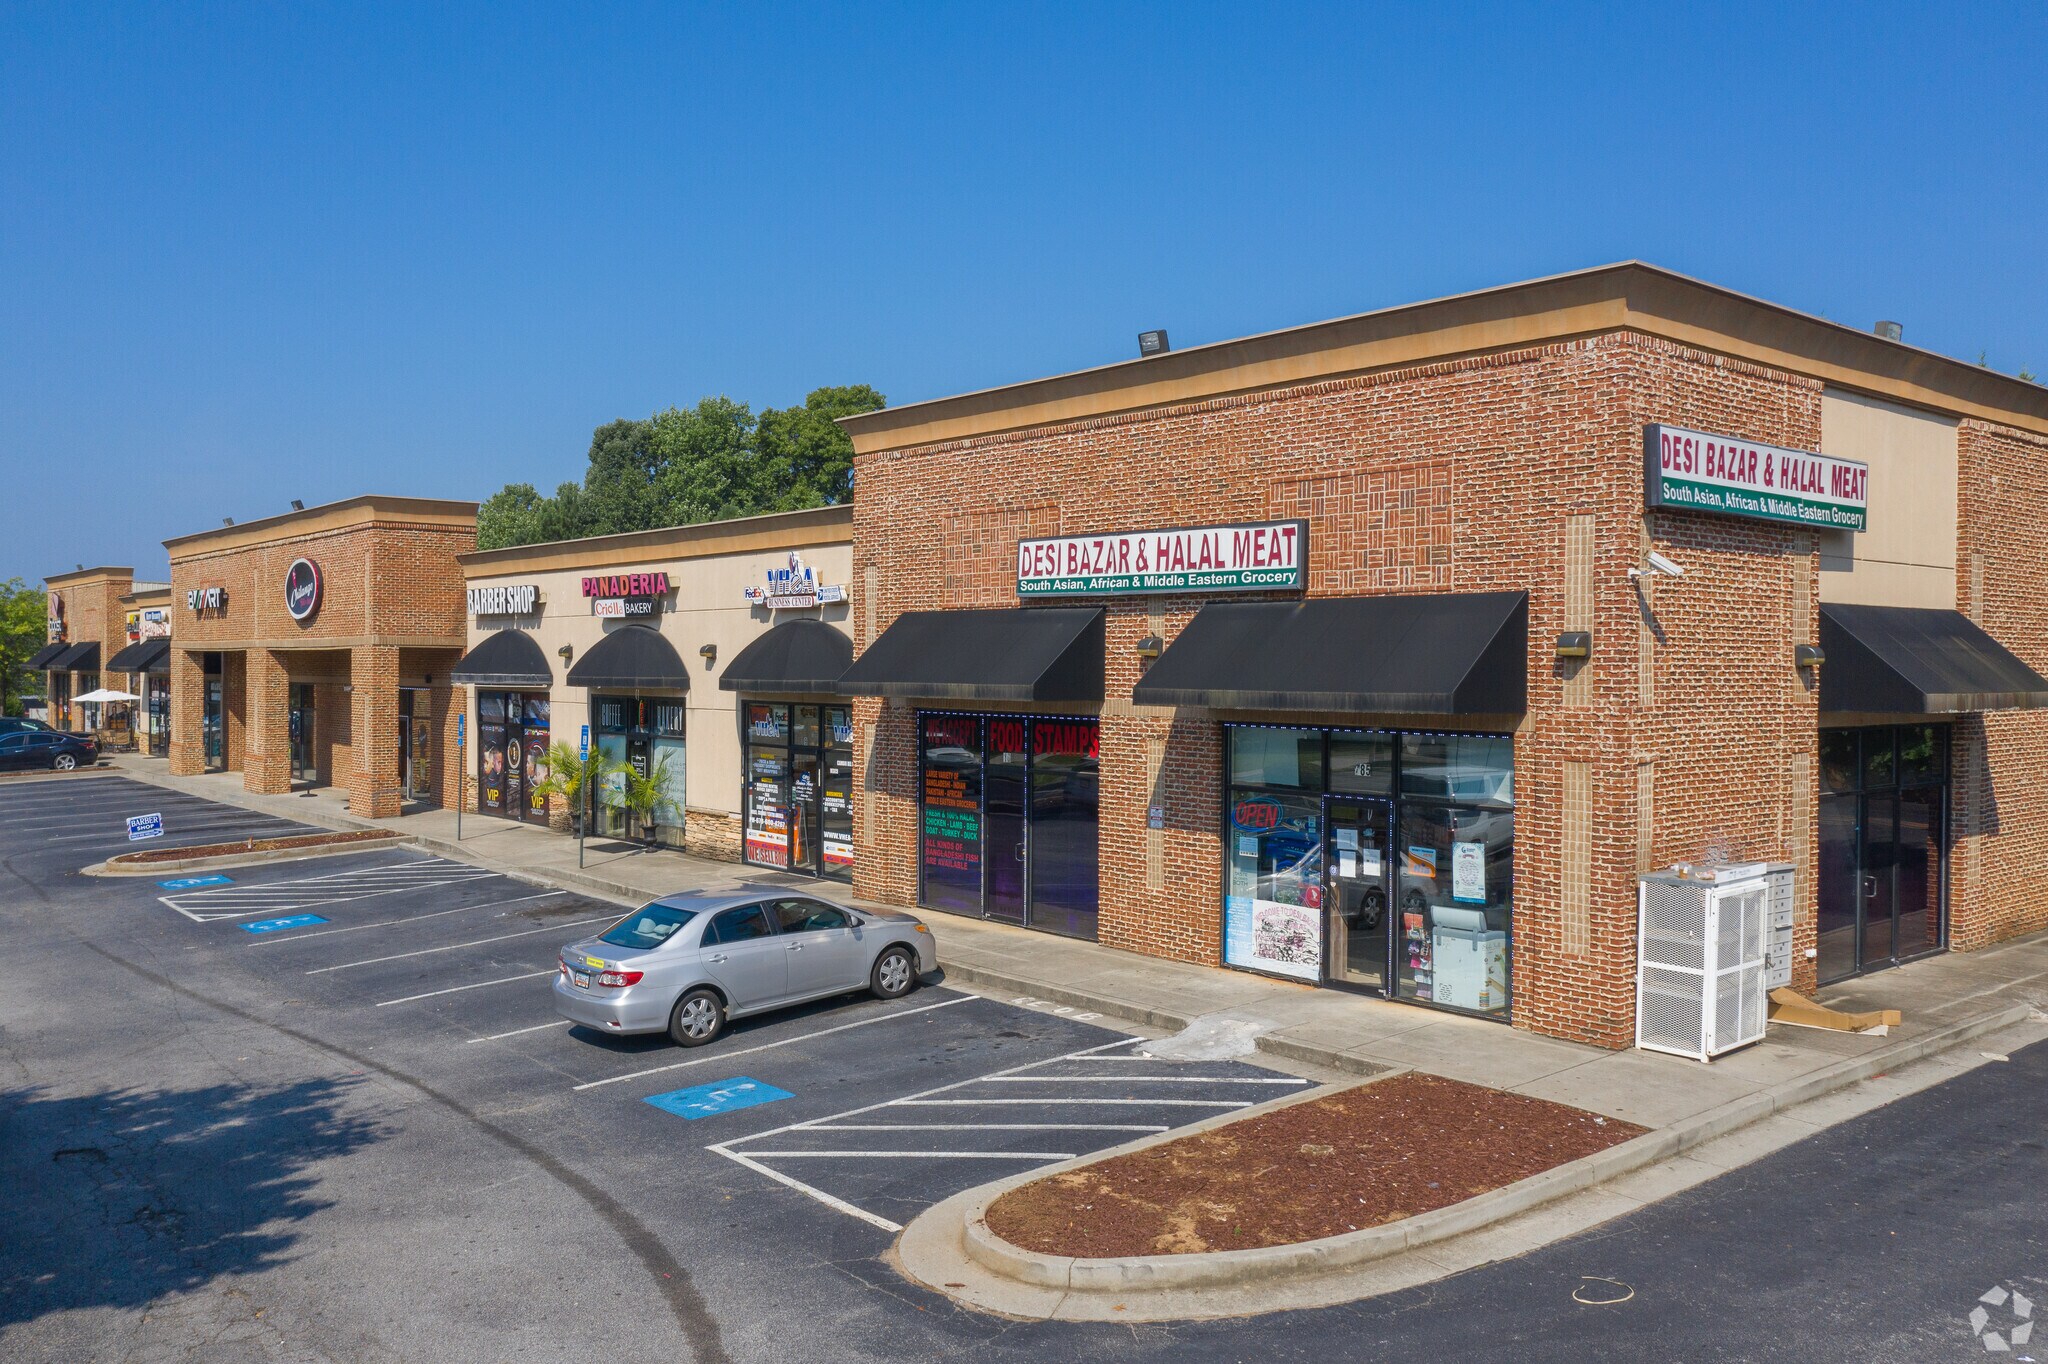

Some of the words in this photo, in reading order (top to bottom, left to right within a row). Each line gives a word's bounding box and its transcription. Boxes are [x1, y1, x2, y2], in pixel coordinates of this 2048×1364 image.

[1661, 433, 1699, 475] DESI
[1706, 442, 1758, 485] BAZAR
[1763, 453, 1774, 487] &
[1780, 456, 1825, 495] HALAL
[1831, 464, 1867, 501] MEAT
[1663, 482, 1692, 503] South
[1694, 487, 1725, 510] Asian,
[1726, 491, 1759, 512] African
[1760, 497, 1768, 512] &
[1768, 498, 1798, 517] Middle
[1798, 503, 1831, 522] Eastern
[1832, 506, 1863, 530] Grocery
[1020, 543, 1062, 577] DESI
[1067, 538, 1130, 576] BAZAR
[1135, 537, 1149, 573] &
[1156, 532, 1226, 572] HALAL
[1232, 527, 1297, 568] MEAT
[582, 572, 668, 597] PANADERIA
[1020, 580, 1051, 591] South
[1053, 579, 1087, 591] Asian,
[1089, 577, 1130, 589] African
[1132, 576, 1141, 587] &
[1144, 574, 1185, 587] Middle
[1188, 573, 1237, 585] Eastern
[1241, 571, 1297, 585] Grocery
[467, 587, 506, 615] BARBER
[507, 585, 535, 614] SHOP
[745, 588, 762, 599] FedEx
[625, 602, 653, 614] BAKERY
[768, 597, 790, 608] BUSINESS
[791, 597, 812, 607] CENTER
[942, 720, 977, 746] ACCEPT
[989, 721, 1023, 753] FOOD
[1034, 723, 1100, 759] STAMPS
[487, 788, 499, 801] VIP
[531, 795, 544, 809] VIP
[956, 799, 977, 809] GROCERIES
[926, 809, 940, 818] FRESH
[960, 813, 975, 822] HALAL
[1235, 801, 1279, 828] OPEN
[130, 816, 159, 828] BARBER
[926, 817, 947, 827] CHICKEN
[950, 820, 963, 829] LAMB
[966, 822, 979, 831] BEEF
[926, 826, 938, 835] GOAT
[942, 828, 960, 837] TURKEY
[964, 831, 977, 840] DUCK
[925, 838, 936, 847] ALL
[937, 840, 954, 850] KINDS
[956, 843, 963, 851] OF
[747, 846, 760, 862] WE
[761, 848, 775, 865] SELL
[775, 850, 788, 867] BOXE
[926, 856, 937, 865] ARE
[938, 859, 968, 870] AVAILABLE
[965, 853, 979, 862] FISH
